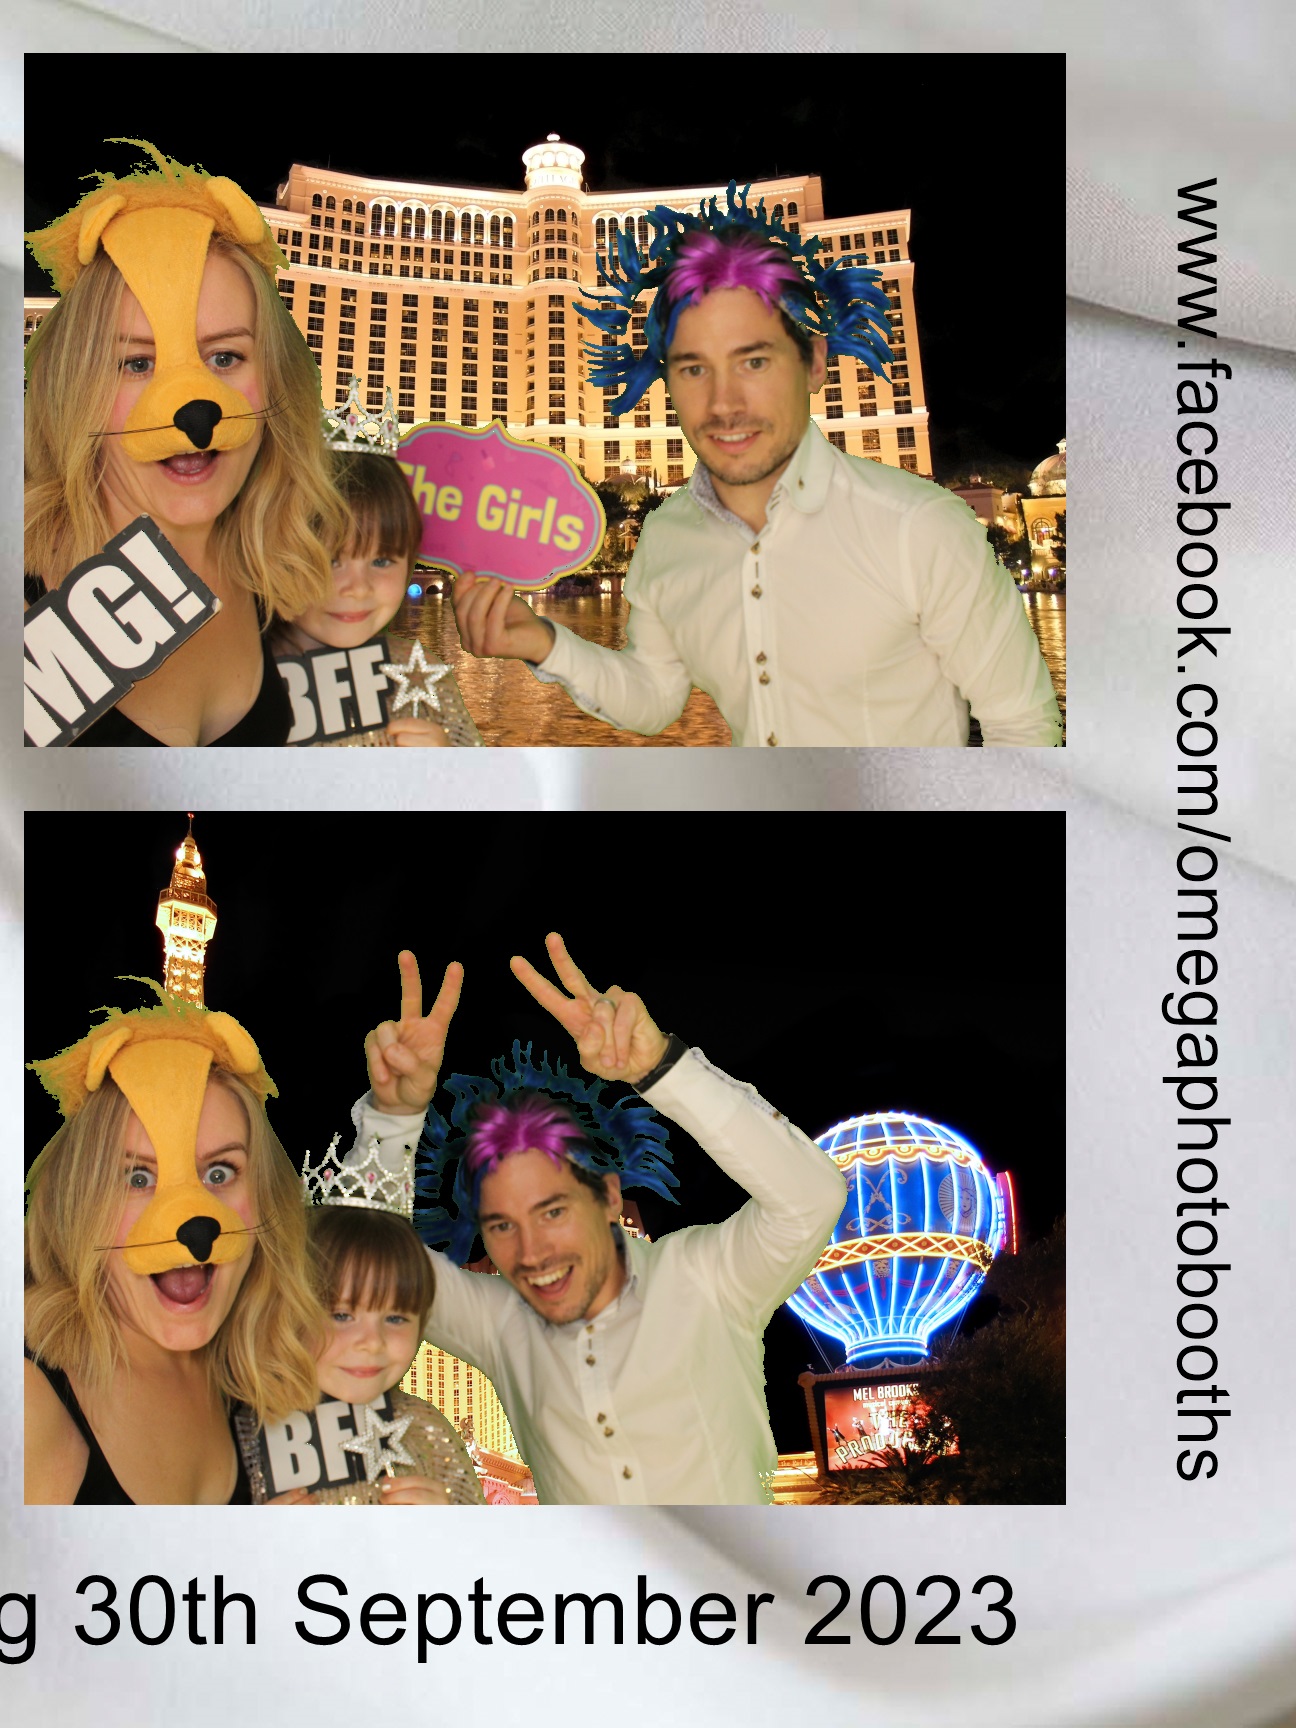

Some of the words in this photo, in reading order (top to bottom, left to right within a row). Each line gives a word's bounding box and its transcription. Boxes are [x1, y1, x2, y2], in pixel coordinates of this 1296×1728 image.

[476, 484, 584, 552] Girls
[24, 529, 206, 747] MG!
[277, 644, 388, 743] BFF
[853, 1387, 875, 1401] MEL
